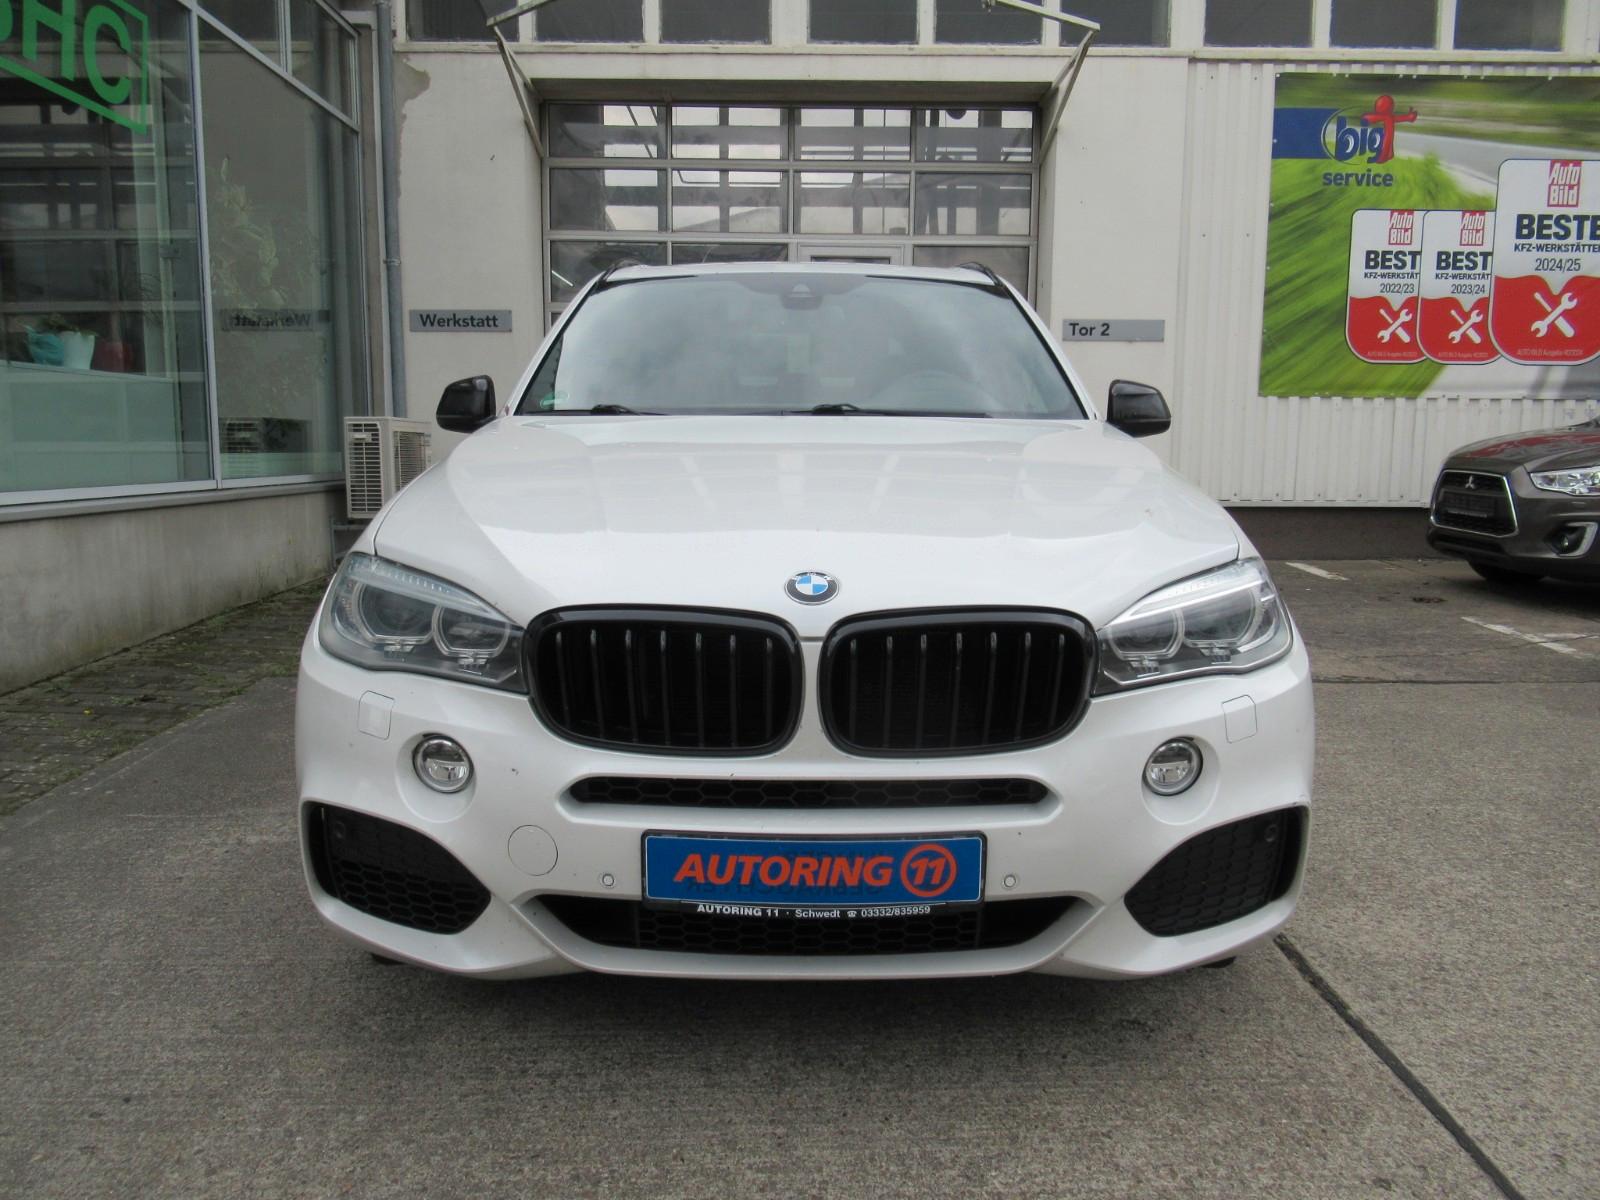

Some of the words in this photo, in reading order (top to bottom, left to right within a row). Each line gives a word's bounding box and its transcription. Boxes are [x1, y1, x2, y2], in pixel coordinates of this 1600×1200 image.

[1322, 170, 1394, 187] service
[1549, 163, 1580, 184] Auto
[1549, 185, 1579, 206] Bild
[1390, 212, 1413, 229] Auto
[1461, 213, 1485, 230] Auto
[1390, 229, 1412, 245] Bild
[1461, 230, 1484, 246] Bild
[1534, 258, 1581, 272] 2024/25
[1379, 283, 1415, 294] 2022/23
[1450, 283, 1486, 295] 2023/24
[419, 313, 499, 328] Werkstatt
[1069, 323, 1096, 336] Tor
[1100, 323, 1110, 336] 2
[673, 853, 893, 887] AUTORING
[910, 857, 946, 885] 11
[696, 903, 763, 917] AUTORING
[765, 908, 780, 918] 11
[795, 908, 841, 919] Schwedt
[861, 906, 932, 918] 03332/835959
